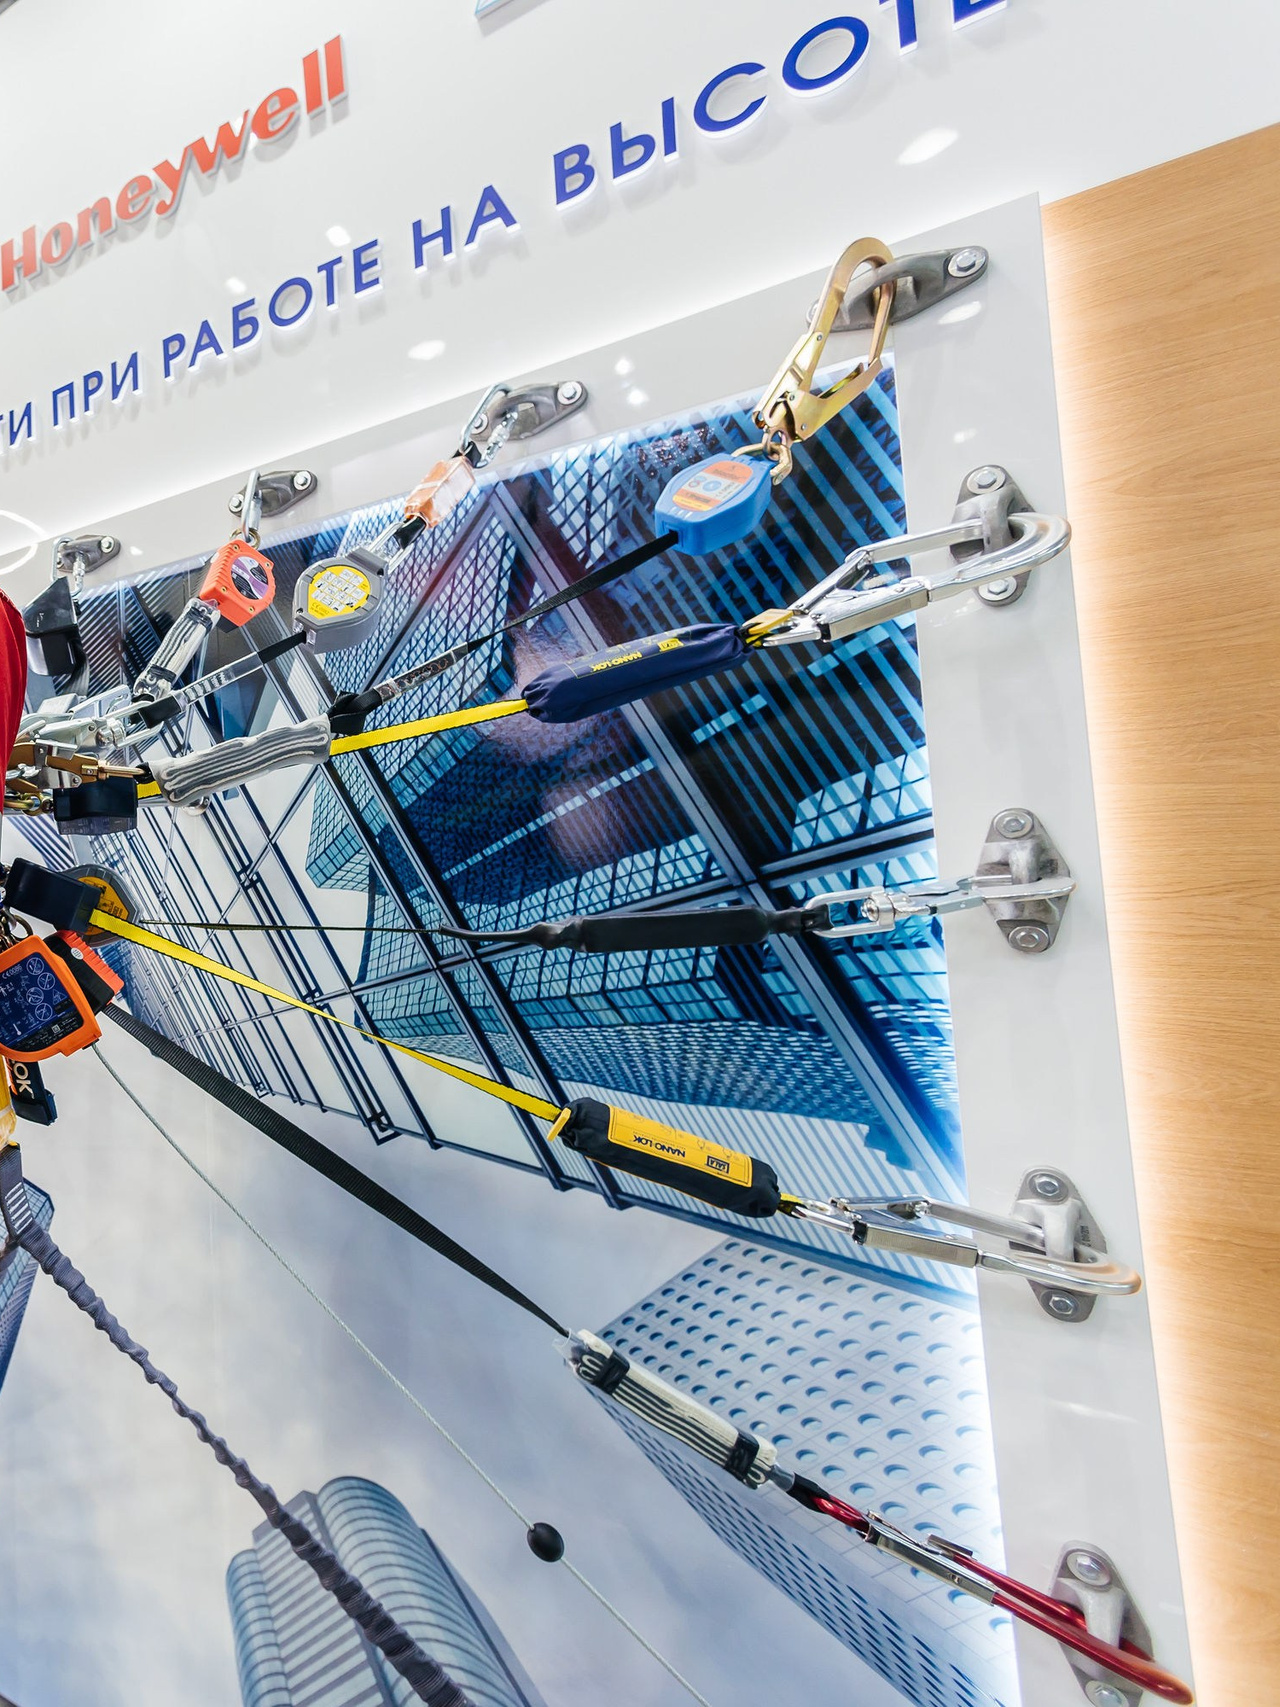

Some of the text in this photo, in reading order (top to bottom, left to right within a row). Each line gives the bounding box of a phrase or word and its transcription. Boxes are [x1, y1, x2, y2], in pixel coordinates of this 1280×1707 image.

[1, 36, 346, 291] Honeywell
[51, 351, 139, 425] ПРИ
[163, 239, 381, 378] РАБОТЕ
[413, 206, 517, 268] НА
[11, 1060, 35, 1100] OK
